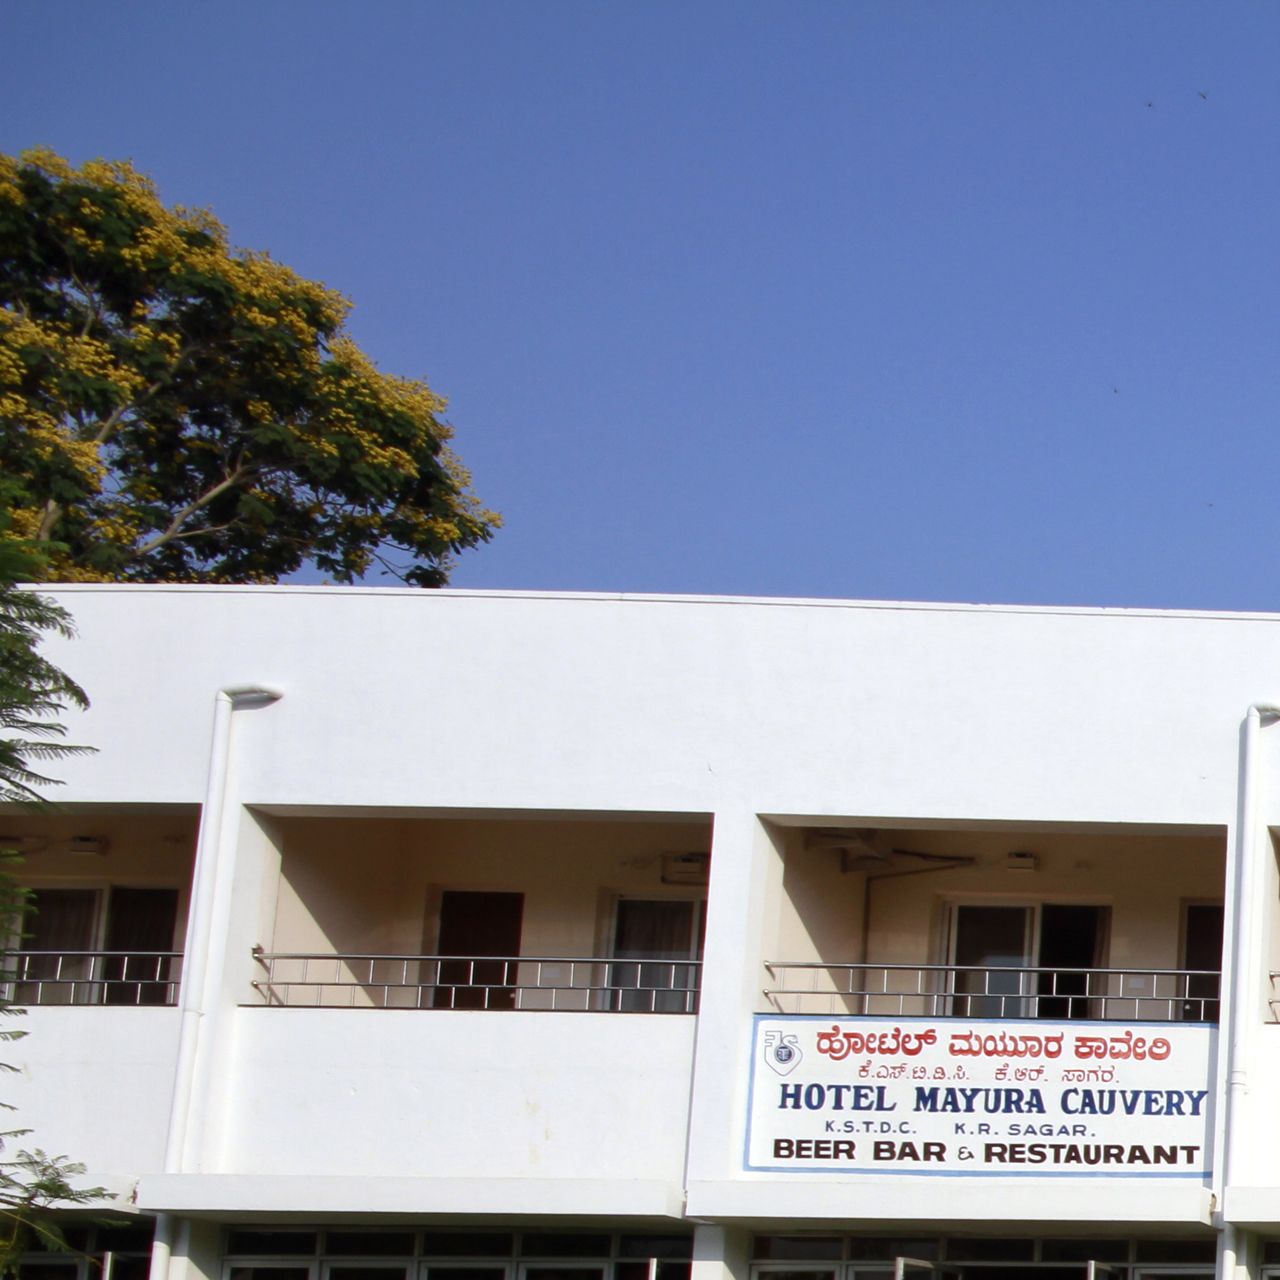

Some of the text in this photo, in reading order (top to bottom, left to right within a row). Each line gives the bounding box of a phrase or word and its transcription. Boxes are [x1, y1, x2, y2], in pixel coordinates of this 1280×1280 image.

[778, 1083, 1208, 1116] HOTEL MAYURA CAUVERY
[825, 1120, 1096, 1137] K.S.T.D.C. K.R. SAGAR.
[773, 1138, 1201, 1165] BEER BAR & RESTAURANT
